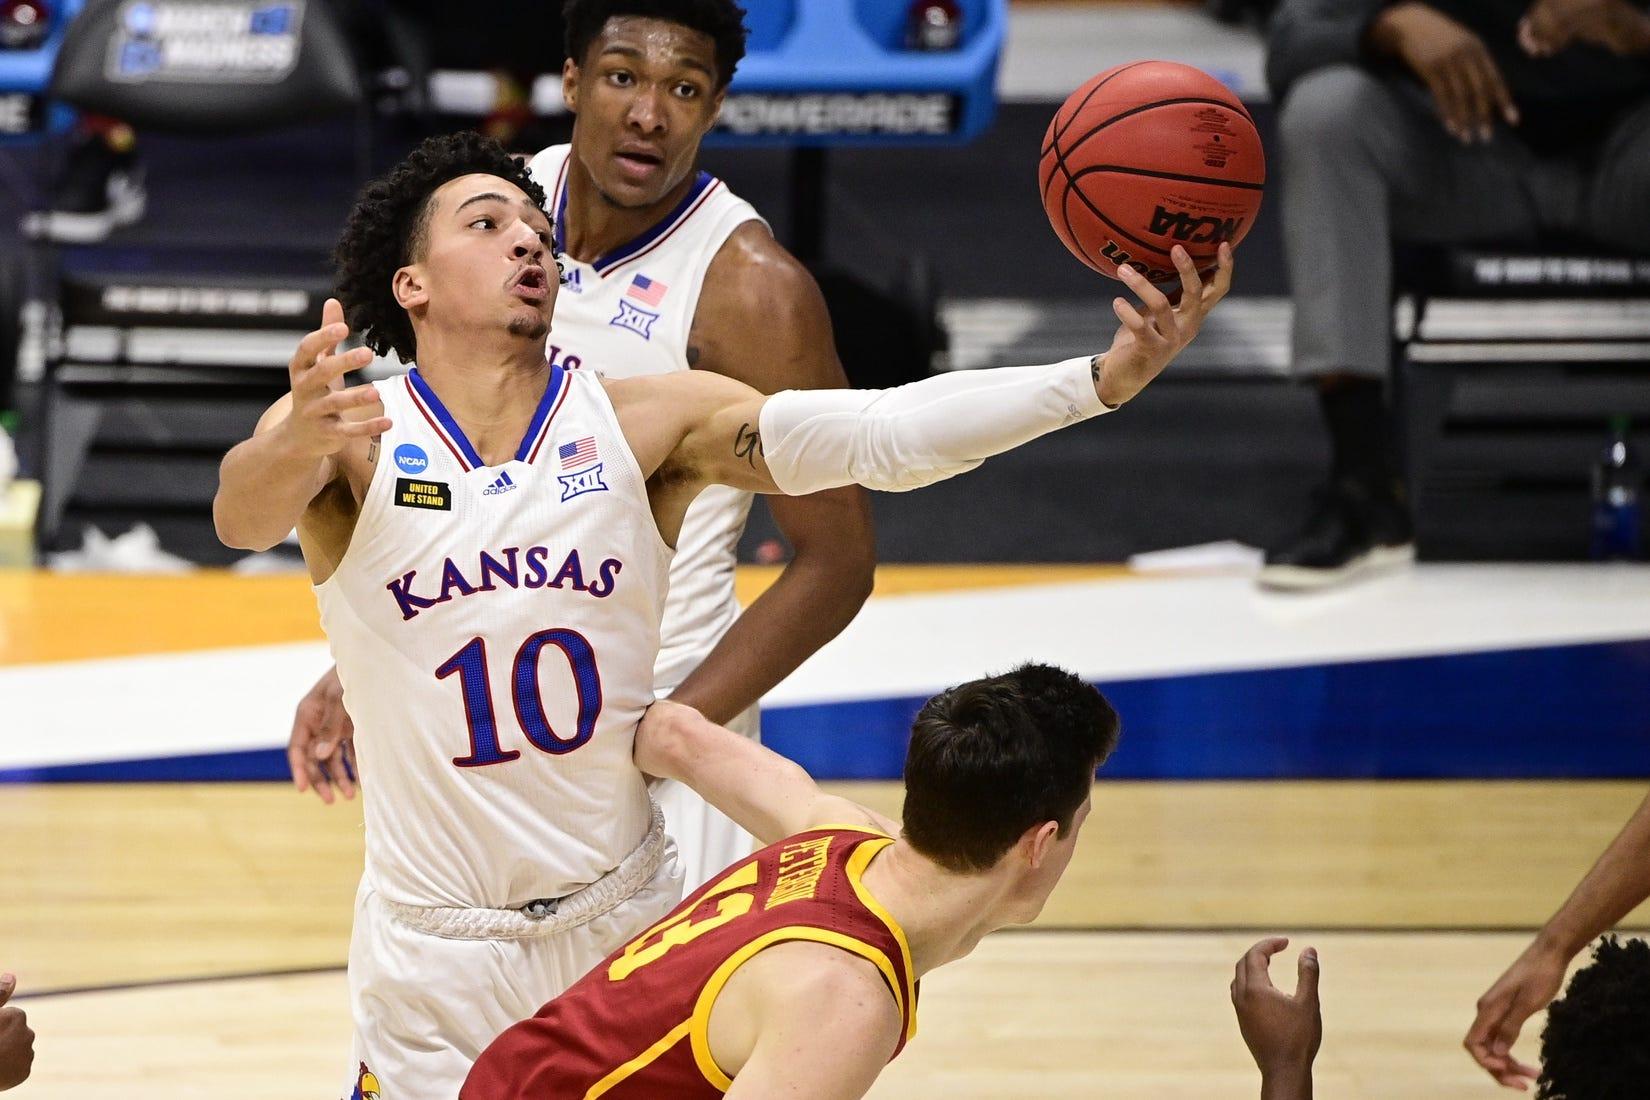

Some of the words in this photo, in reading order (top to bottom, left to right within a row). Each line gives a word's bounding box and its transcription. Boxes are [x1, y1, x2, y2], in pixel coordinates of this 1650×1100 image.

[1149, 205, 1244, 244] NCAA
[398, 456, 427, 467] NCAA
[402, 493, 416, 503] WE
[416, 495, 444, 507] STAND
[408, 483, 439, 495] UNITED
[482, 484, 517, 496] adidas
[386, 547, 623, 621] KANSAS
[435, 628, 603, 767] 10
[607, 860, 758, 981] 13
